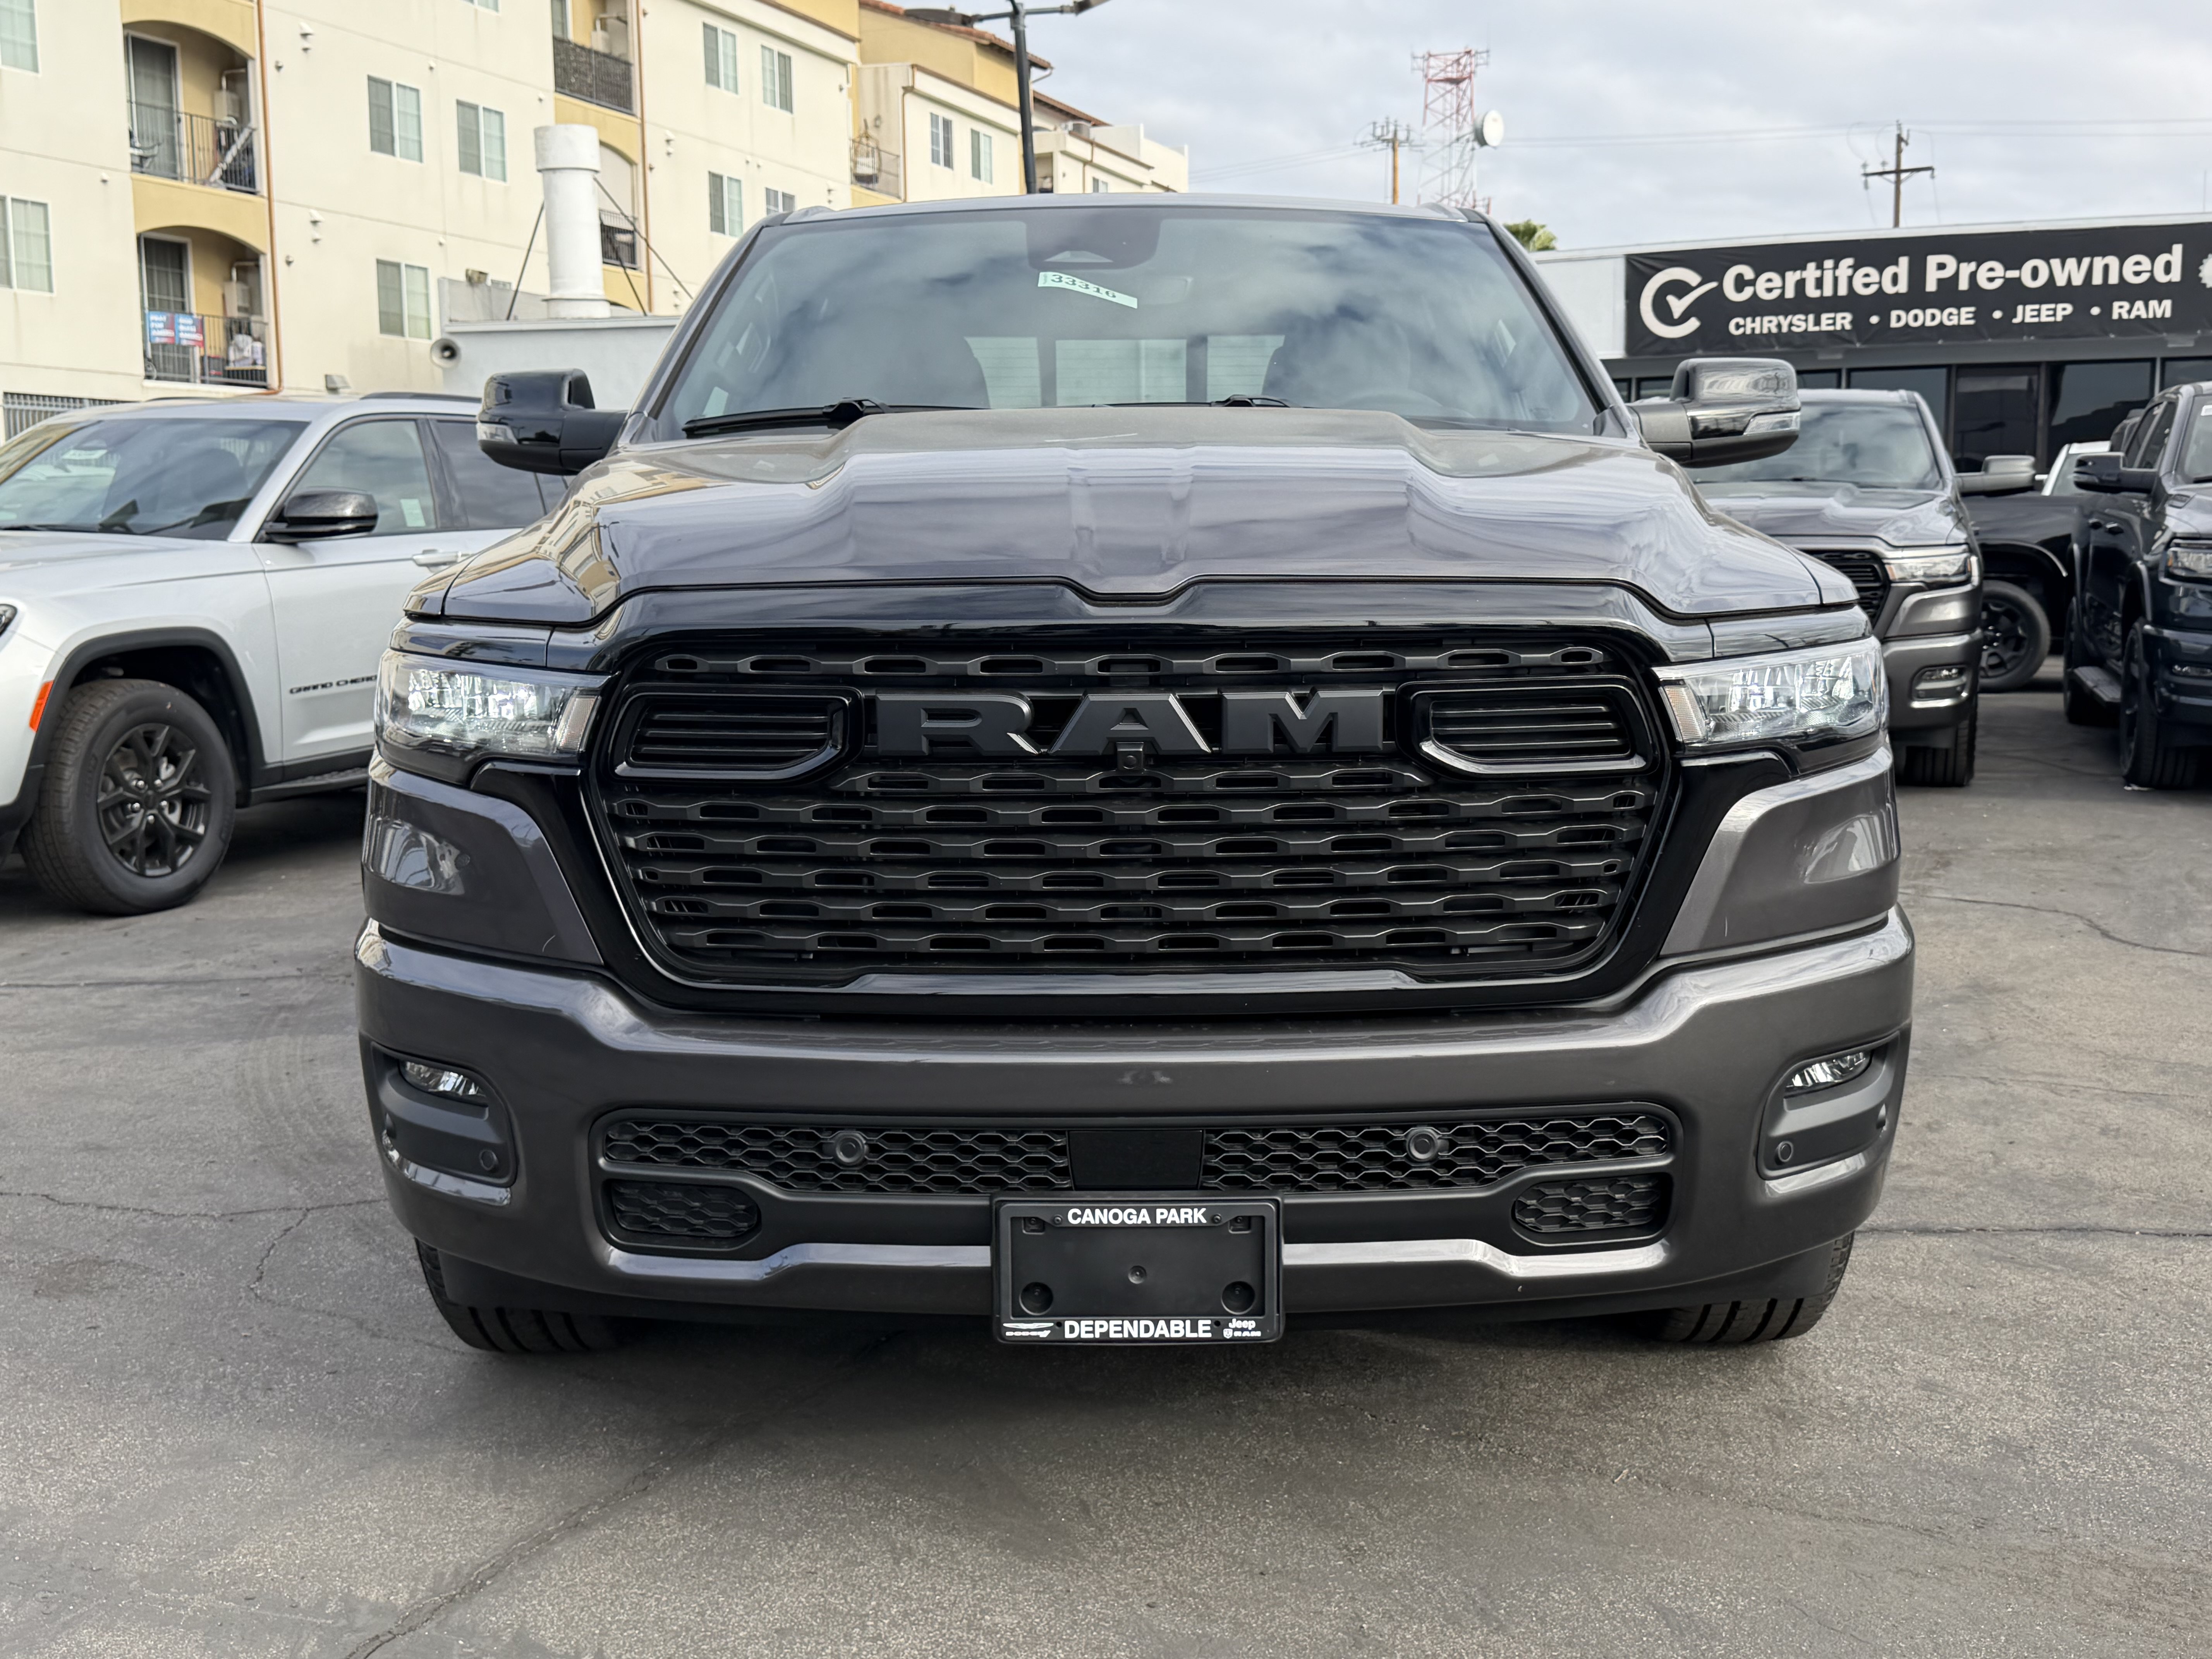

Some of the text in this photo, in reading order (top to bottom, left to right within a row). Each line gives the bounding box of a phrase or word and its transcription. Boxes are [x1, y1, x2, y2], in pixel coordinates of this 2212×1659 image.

[1723, 244, 2183, 302] Certifed Pre-owned
[1051, 274, 1116, 298] 33316
[1728, 299, 2172, 336] CHRYSLER DODGE JEEP RAM
[876, 692, 1384, 756] RAM
[1067, 1208, 1207, 1224] CANOGA PARK
[1064, 1319, 1212, 1338] DEPENDABLE
[1228, 1318, 1256, 1330] Jeep
